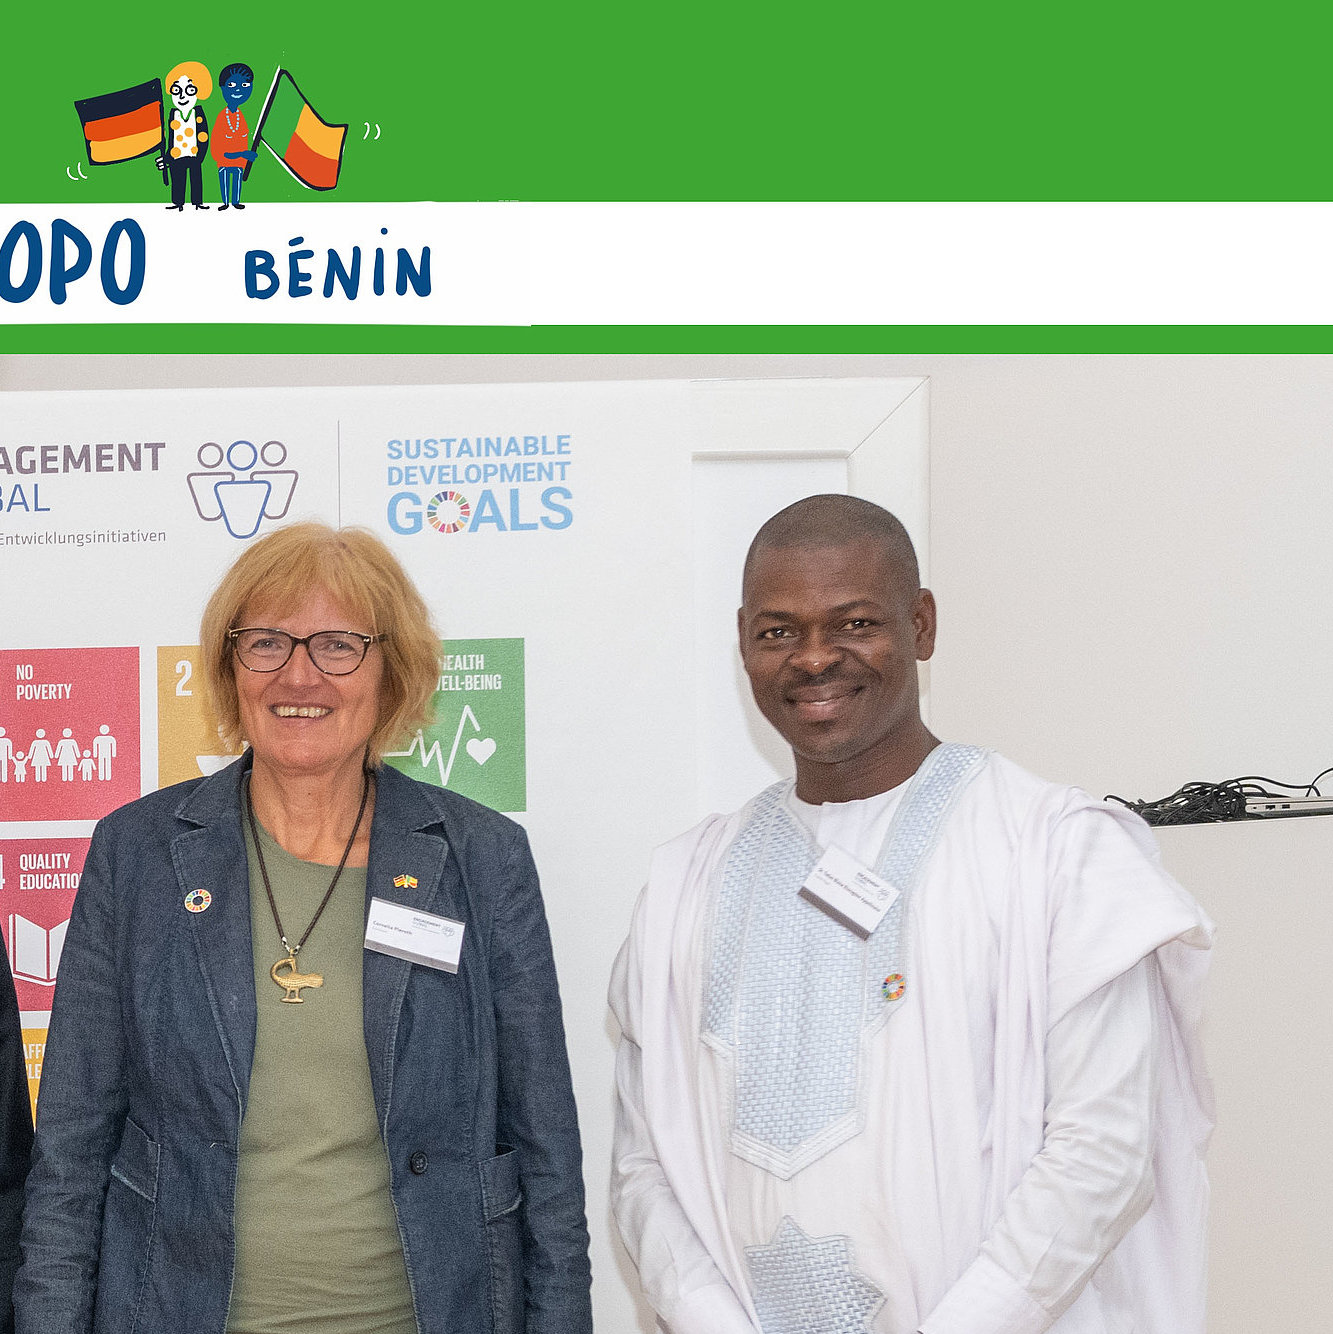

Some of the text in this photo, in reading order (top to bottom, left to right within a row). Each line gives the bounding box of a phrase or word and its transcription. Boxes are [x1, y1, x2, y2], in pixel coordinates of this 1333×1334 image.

[387, 434, 571, 460] SUSTAINABLE
[387, 461, 571, 486] DEVELOPMENT
[387, 486, 573, 535] GOALS
[16, 664, 34, 681] NO
[175, 660, 193, 697] 2
[16, 683, 72, 700] POVERTY
[19, 853, 71, 870] QUALITY
